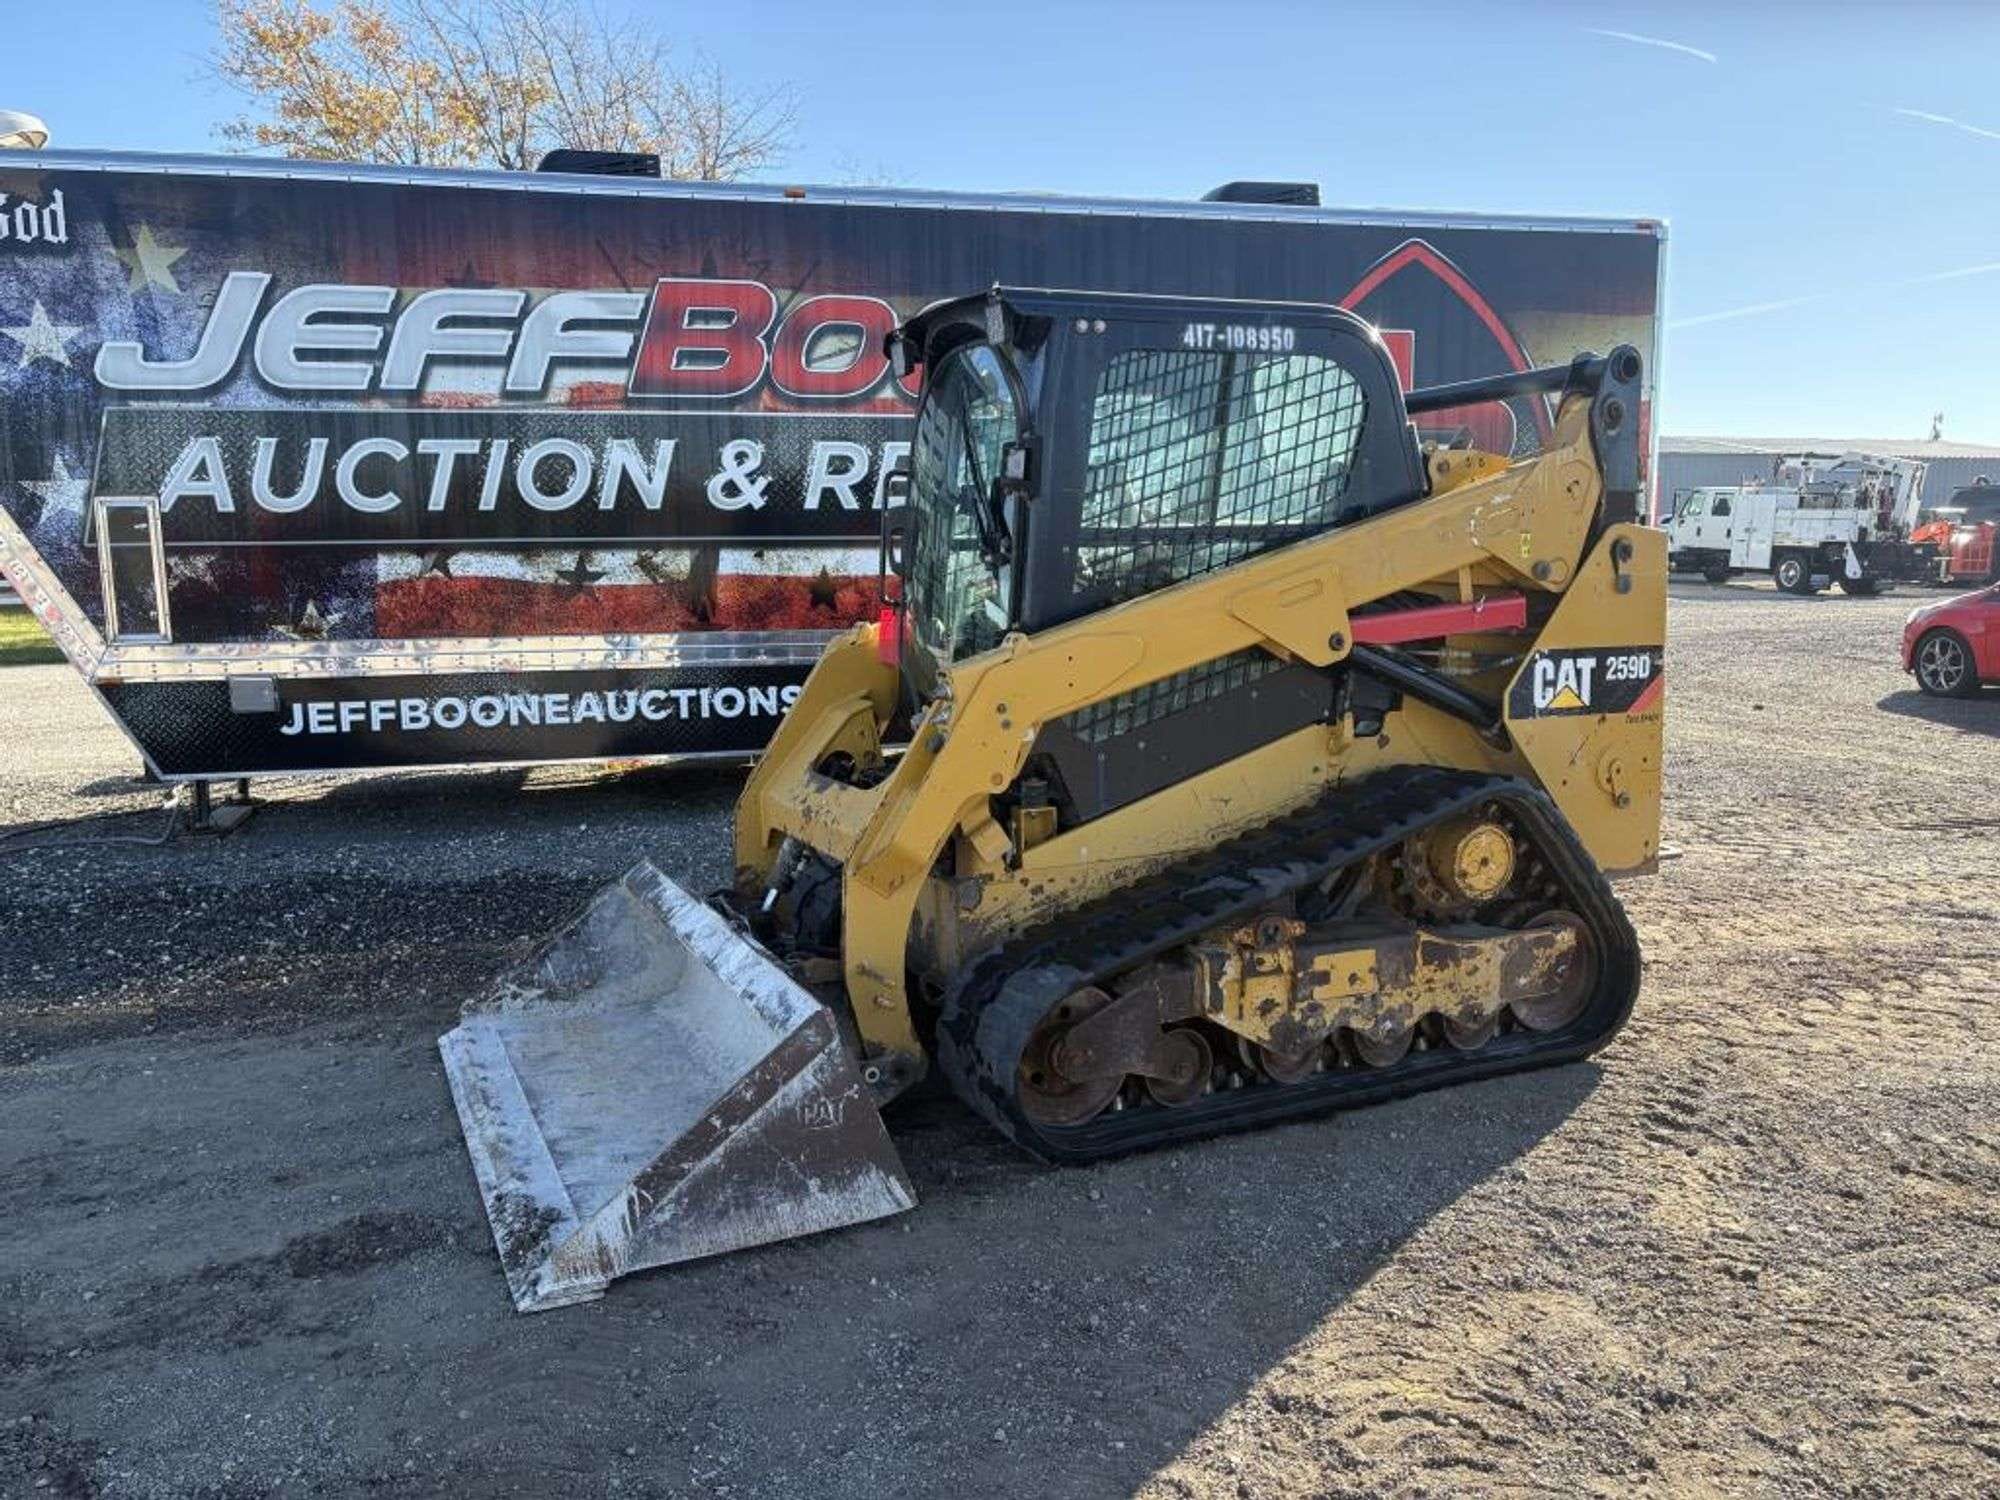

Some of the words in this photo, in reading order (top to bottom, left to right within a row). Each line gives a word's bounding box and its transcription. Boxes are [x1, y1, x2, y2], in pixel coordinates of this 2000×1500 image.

[1184, 323, 1295, 351] 417-108950
[160, 437, 678, 514] AUCTION
[707, 438, 770, 511] &
[1533, 657, 1597, 709] CAT
[1605, 653, 1651, 682] 259D
[279, 685, 802, 736] JEFFBOONEAUCTIONS
